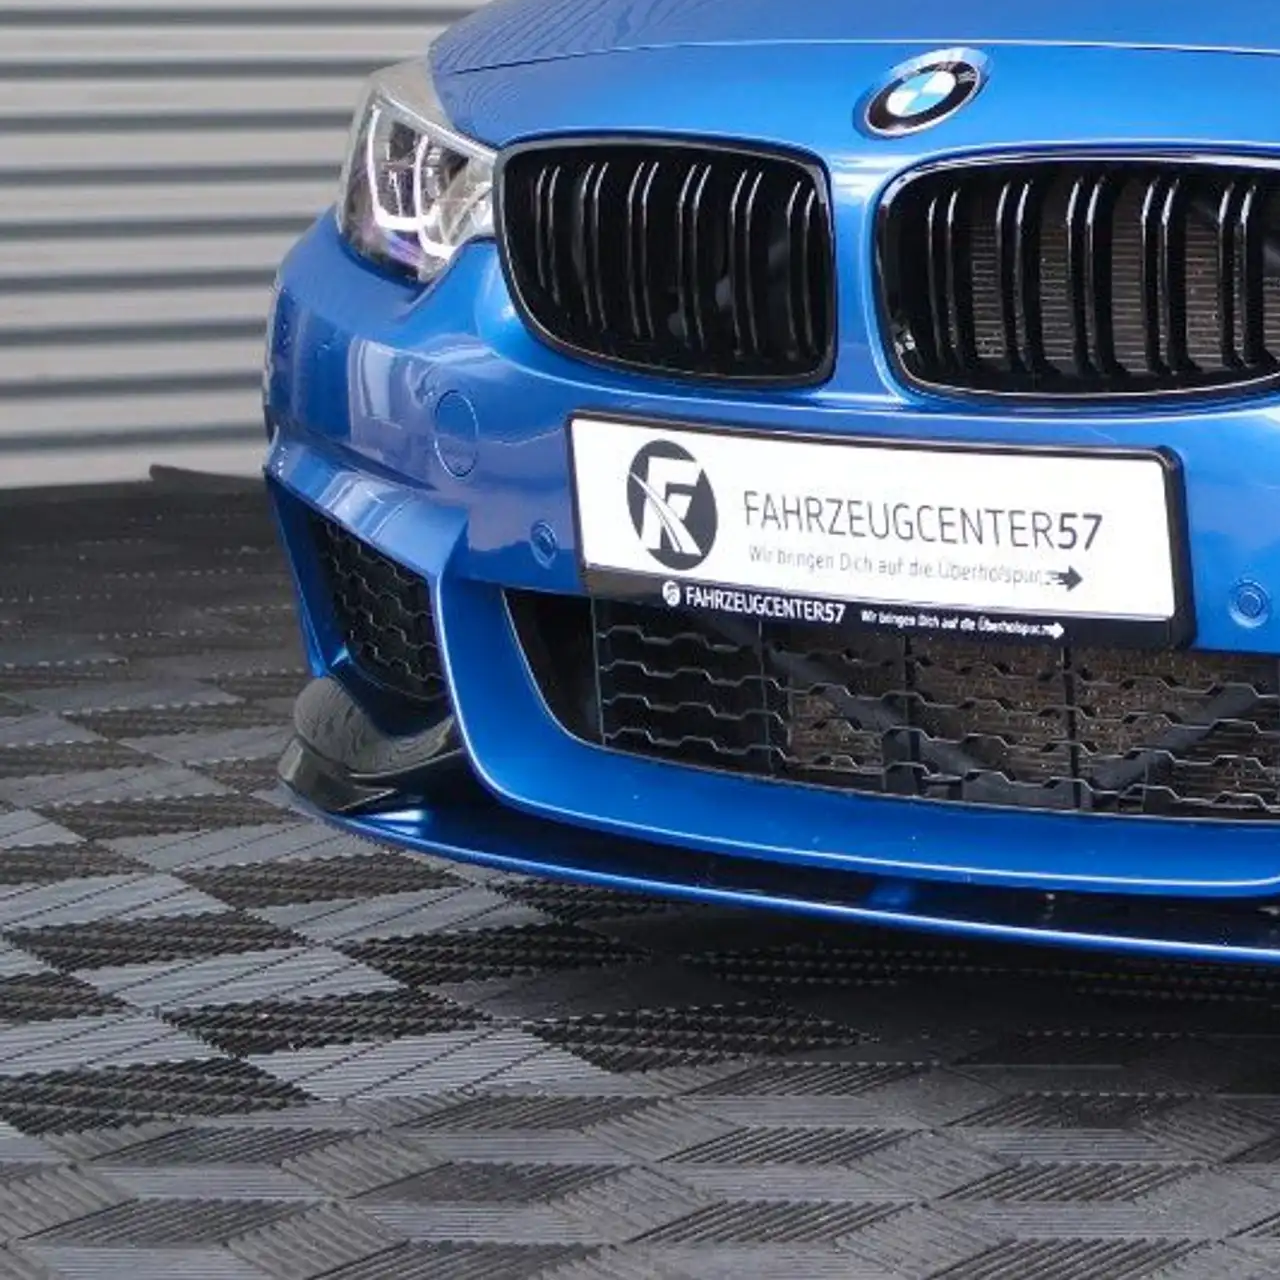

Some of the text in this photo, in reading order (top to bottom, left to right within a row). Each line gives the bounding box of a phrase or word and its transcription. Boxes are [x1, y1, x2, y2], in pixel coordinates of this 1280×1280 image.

[743, 489, 1103, 552] FAHRZEUGCENTER57
[749, 544, 774, 563] Wir
[777, 547, 835, 574] bringen
[839, 551, 873, 572] Dich
[878, 554, 905, 576] auf
[685, 585, 847, 625] FAHRZEUGCENTER57
